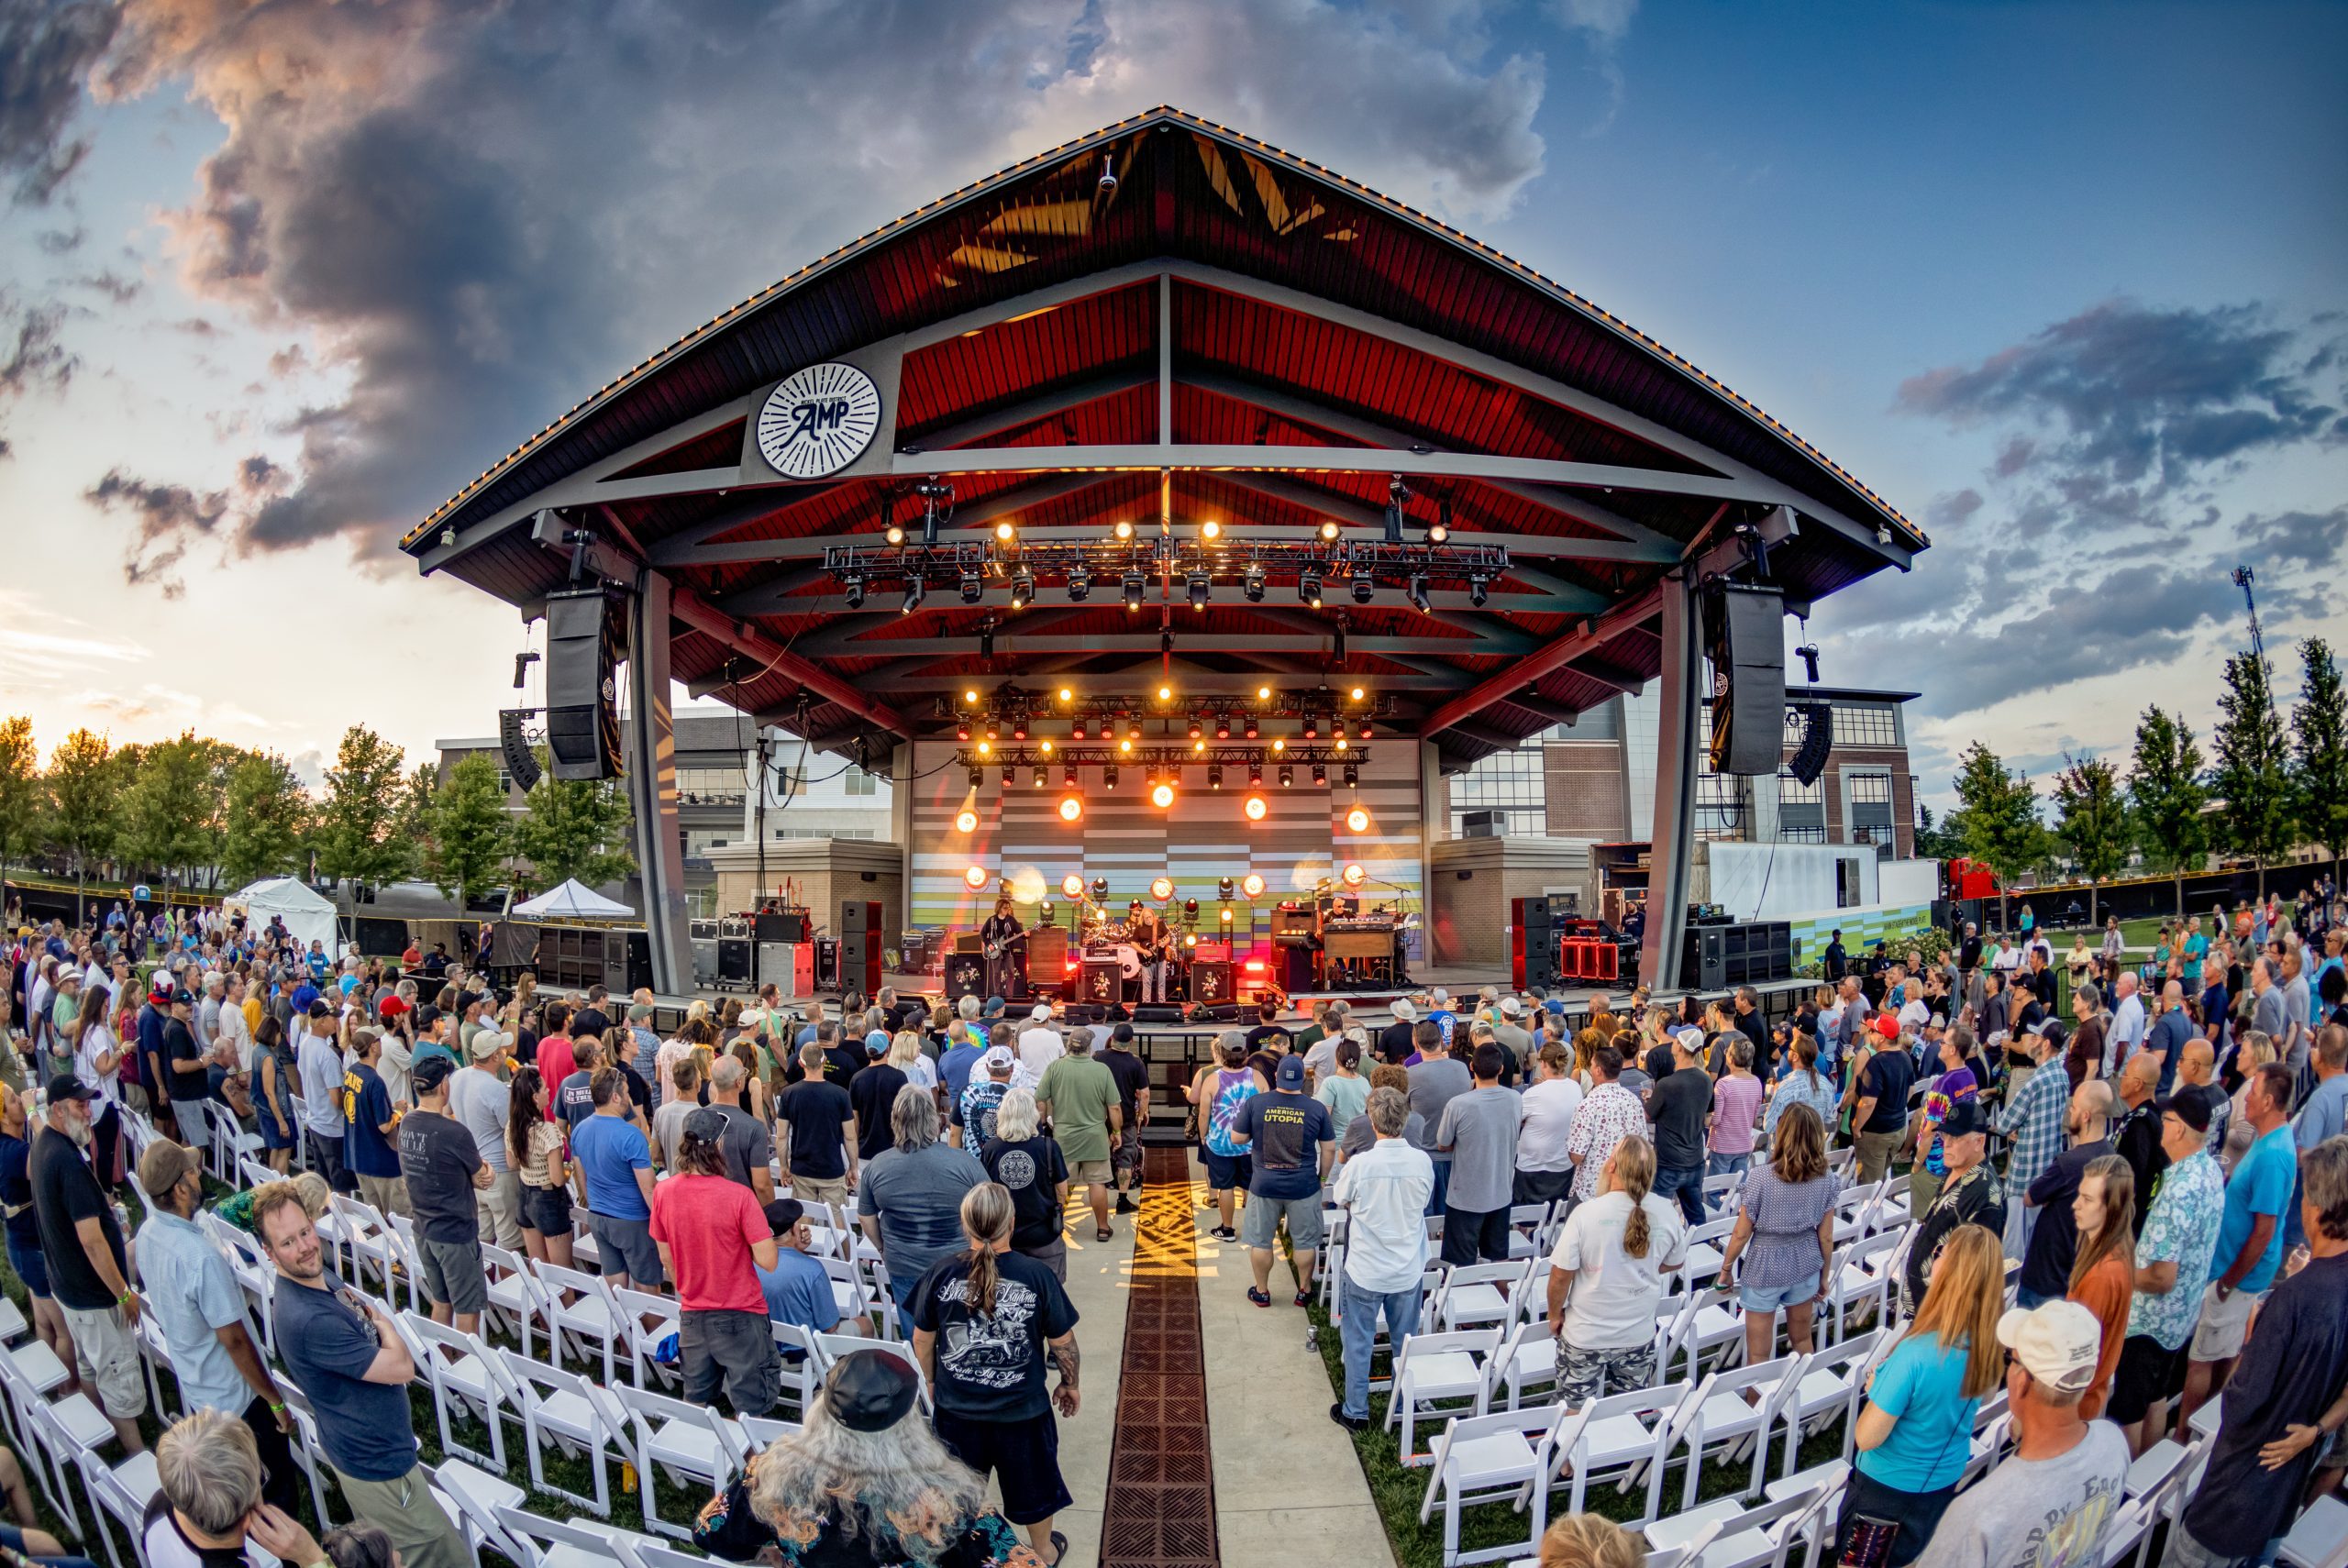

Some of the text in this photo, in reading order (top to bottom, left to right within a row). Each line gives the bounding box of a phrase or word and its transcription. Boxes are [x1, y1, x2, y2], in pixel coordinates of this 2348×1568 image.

[778, 402, 849, 449] AMP
[1266, 1108, 1305, 1117] AMERICAN
[1264, 1114, 1304, 1124] UTOPIA
